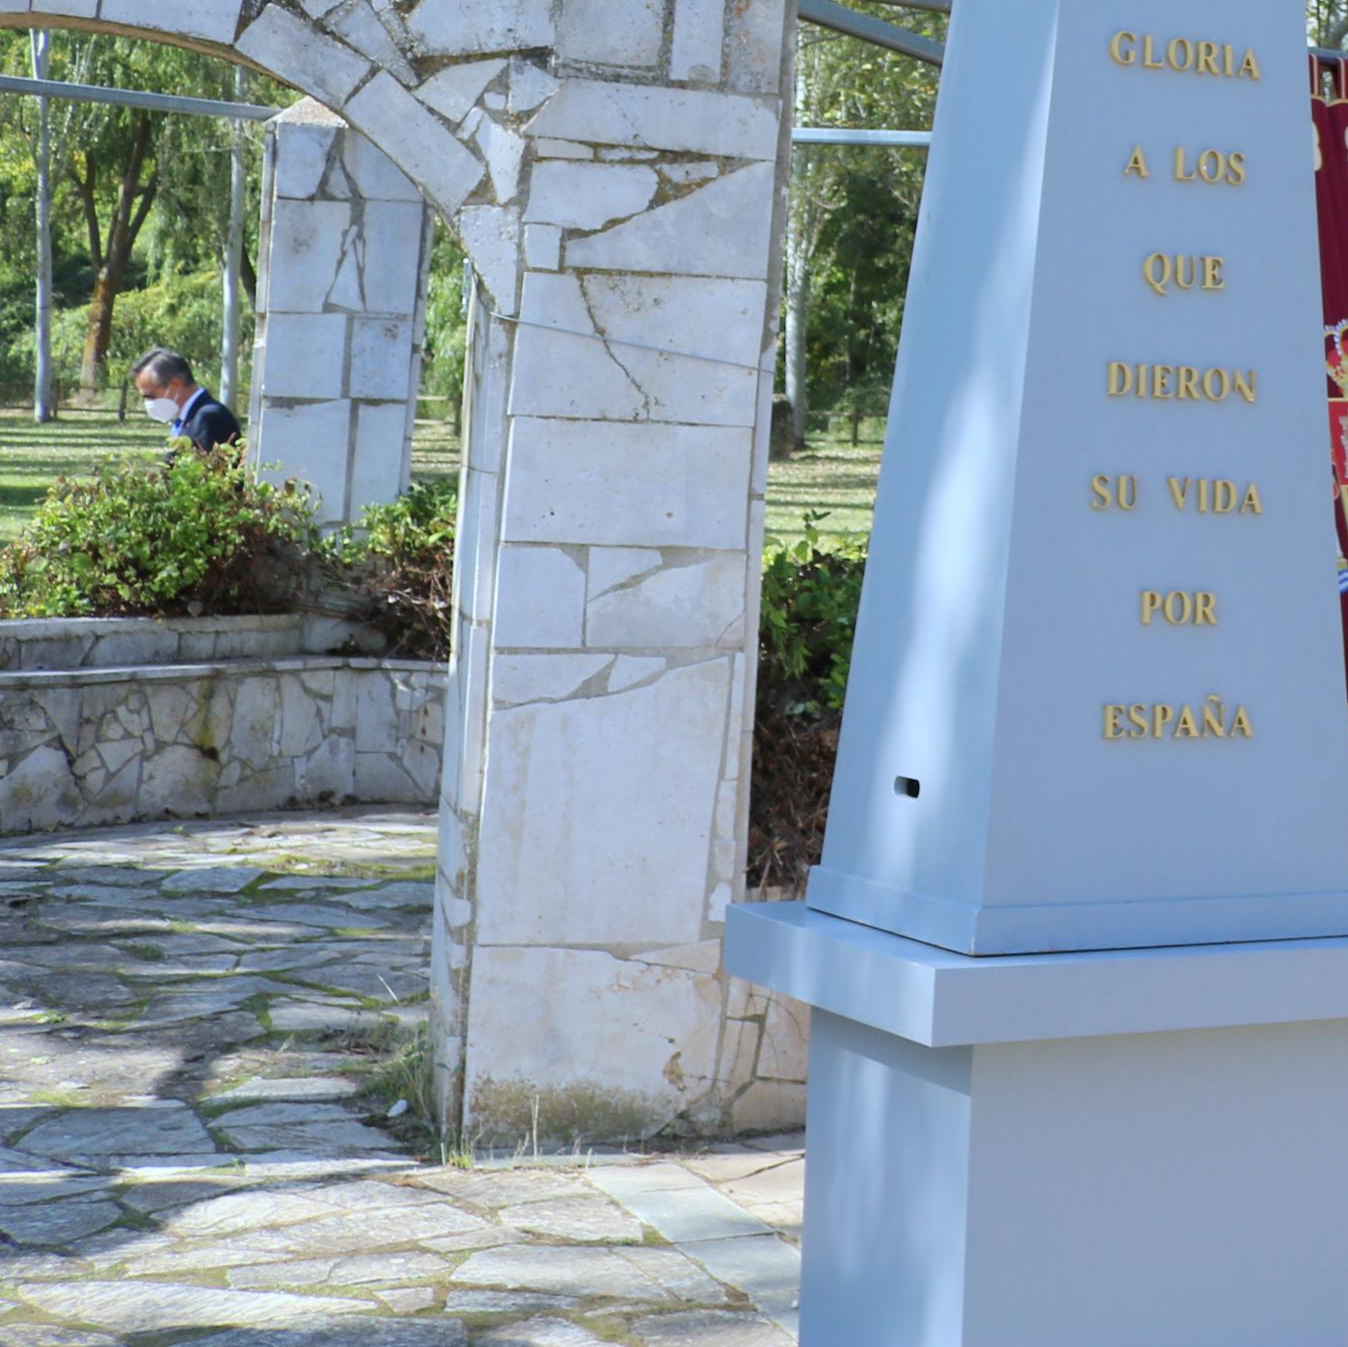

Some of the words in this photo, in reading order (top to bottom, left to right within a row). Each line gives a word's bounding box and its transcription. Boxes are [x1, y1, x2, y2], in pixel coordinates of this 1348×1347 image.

[1109, 31, 1261, 81] GLORIA
[1122, 146, 1150, 180] A
[1172, 147, 1246, 187] LOS
[1142, 252, 1226, 297] QUE
[1107, 361, 1259, 404] DIERON
[1090, 474, 1139, 512] SU
[1167, 477, 1264, 515] VIDA
[1140, 590, 1218, 627] POR
[1103, 694, 1254, 741] ESPAÑA
